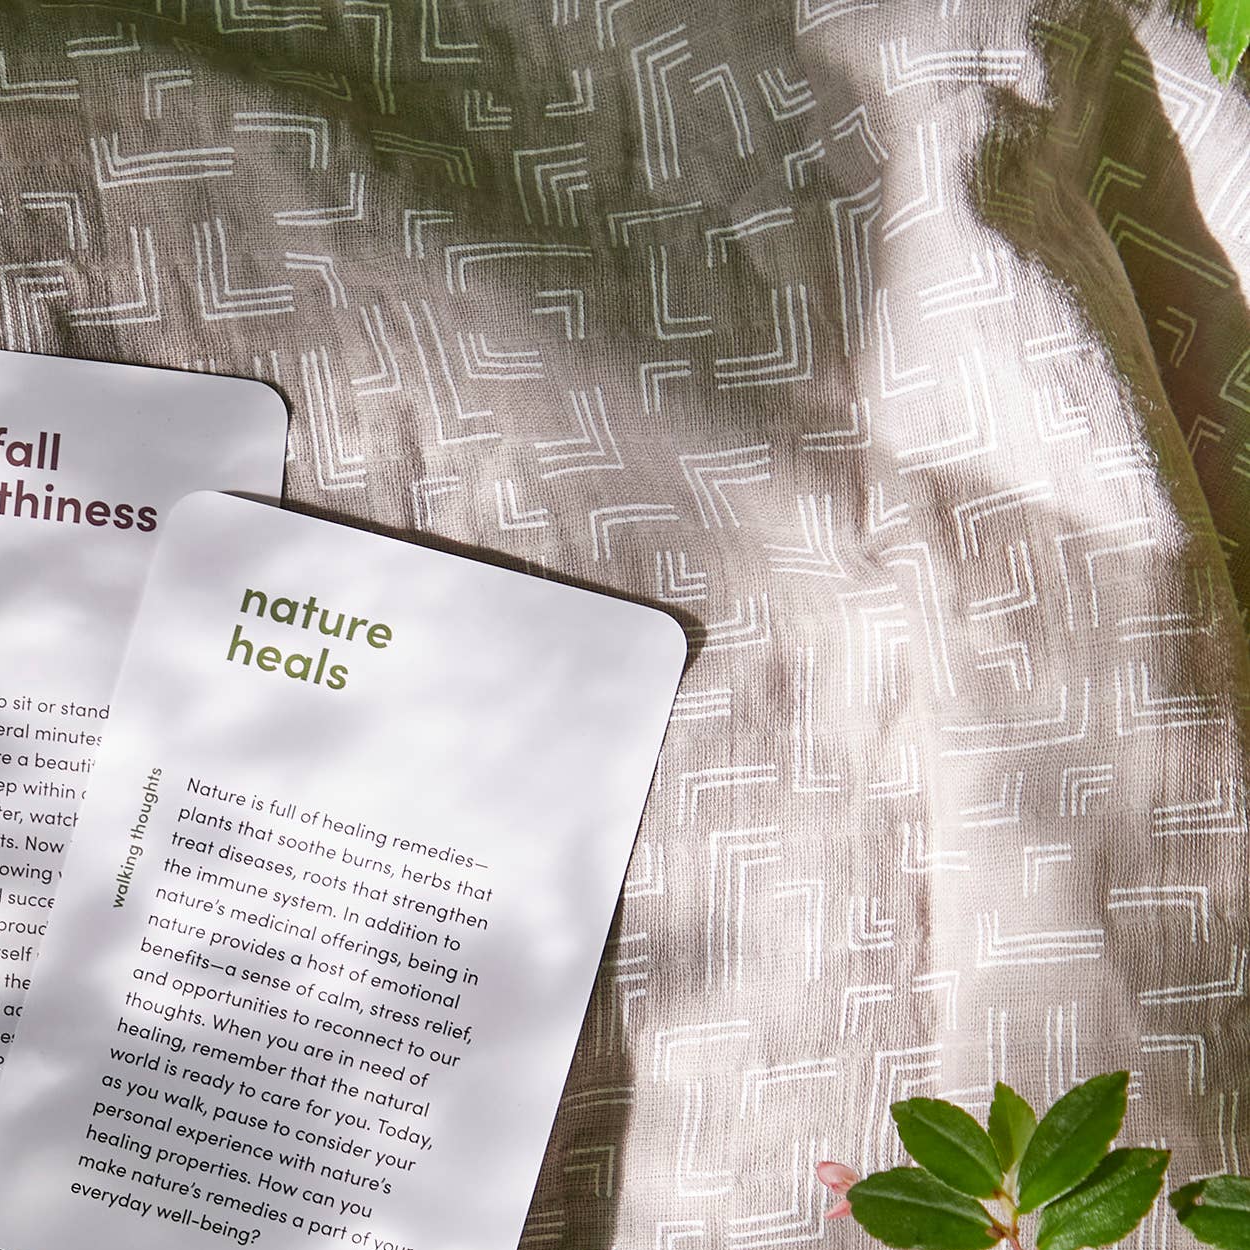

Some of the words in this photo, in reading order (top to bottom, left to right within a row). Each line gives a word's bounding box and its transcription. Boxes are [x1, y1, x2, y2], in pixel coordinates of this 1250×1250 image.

[226, 623, 349, 690] heals
[239, 588, 393, 649] nature
[12, 695, 33, 712] sit
[37, 702, 57, 714] or
[60, 701, 111, 720] stand
[22, 780, 76, 800] within
[112, 844, 144, 908] walking
[130, 767, 163, 840] thoughts
[24, 835, 65, 854] Now
[177, 805, 234, 832] plants
[237, 820, 274, 843] that
[277, 835, 337, 860] soothe
[341, 847, 395, 879] burns,
[401, 863, 452, 891] herbs
[456, 880, 493, 902] that
[163, 857, 192, 878] the
[196, 865, 268, 899] immune
[272, 891, 337, 919] system.
[343, 906, 360, 924] In
[364, 916, 439, 946] addition
[443, 934, 461, 952] to
[4, 972, 32, 991] the
[147, 914, 206, 939] nature
[208, 932, 286, 962] provides
[290, 953, 303, 966] a
[306, 953, 345, 977] host
[348, 968, 370, 984] of
[370, 976, 461, 1010] emotional
[125, 991, 206, 1027] thoughts.
[213, 1013, 262, 1043] When
[265, 1033, 300, 1053] you
[303, 1044, 334, 1062] are
[338, 1049, 355, 1068] in
[358, 1059, 406, 1082] need
[409, 1072, 431, 1088] of
[132, 968, 169, 987] and
[171, 979, 289, 1021] opportunities
[292, 1008, 310, 1026] to
[314, 1018, 405, 1052] reconnect
[407, 1040, 425, 1058] to
[429, 1050, 461, 1067] our
[85, 1123, 153, 1161] healing
[155, 1147, 252, 1185] properties.
[257, 1172, 299, 1197] How
[301, 1189, 335, 1209] can
[339, 1199, 373, 1219] you
[101, 1075, 123, 1090] as
[125, 1081, 160, 1101] you
[164, 1091, 208, 1118] walk,
[211, 1105, 269, 1131] pause
[272, 1119, 291, 1137] to
[294, 1129, 373, 1159] consider
[374, 1151, 417, 1172] your
[70, 1182, 153, 1218] everyday
[156, 1205, 262, 1246] well-being?
